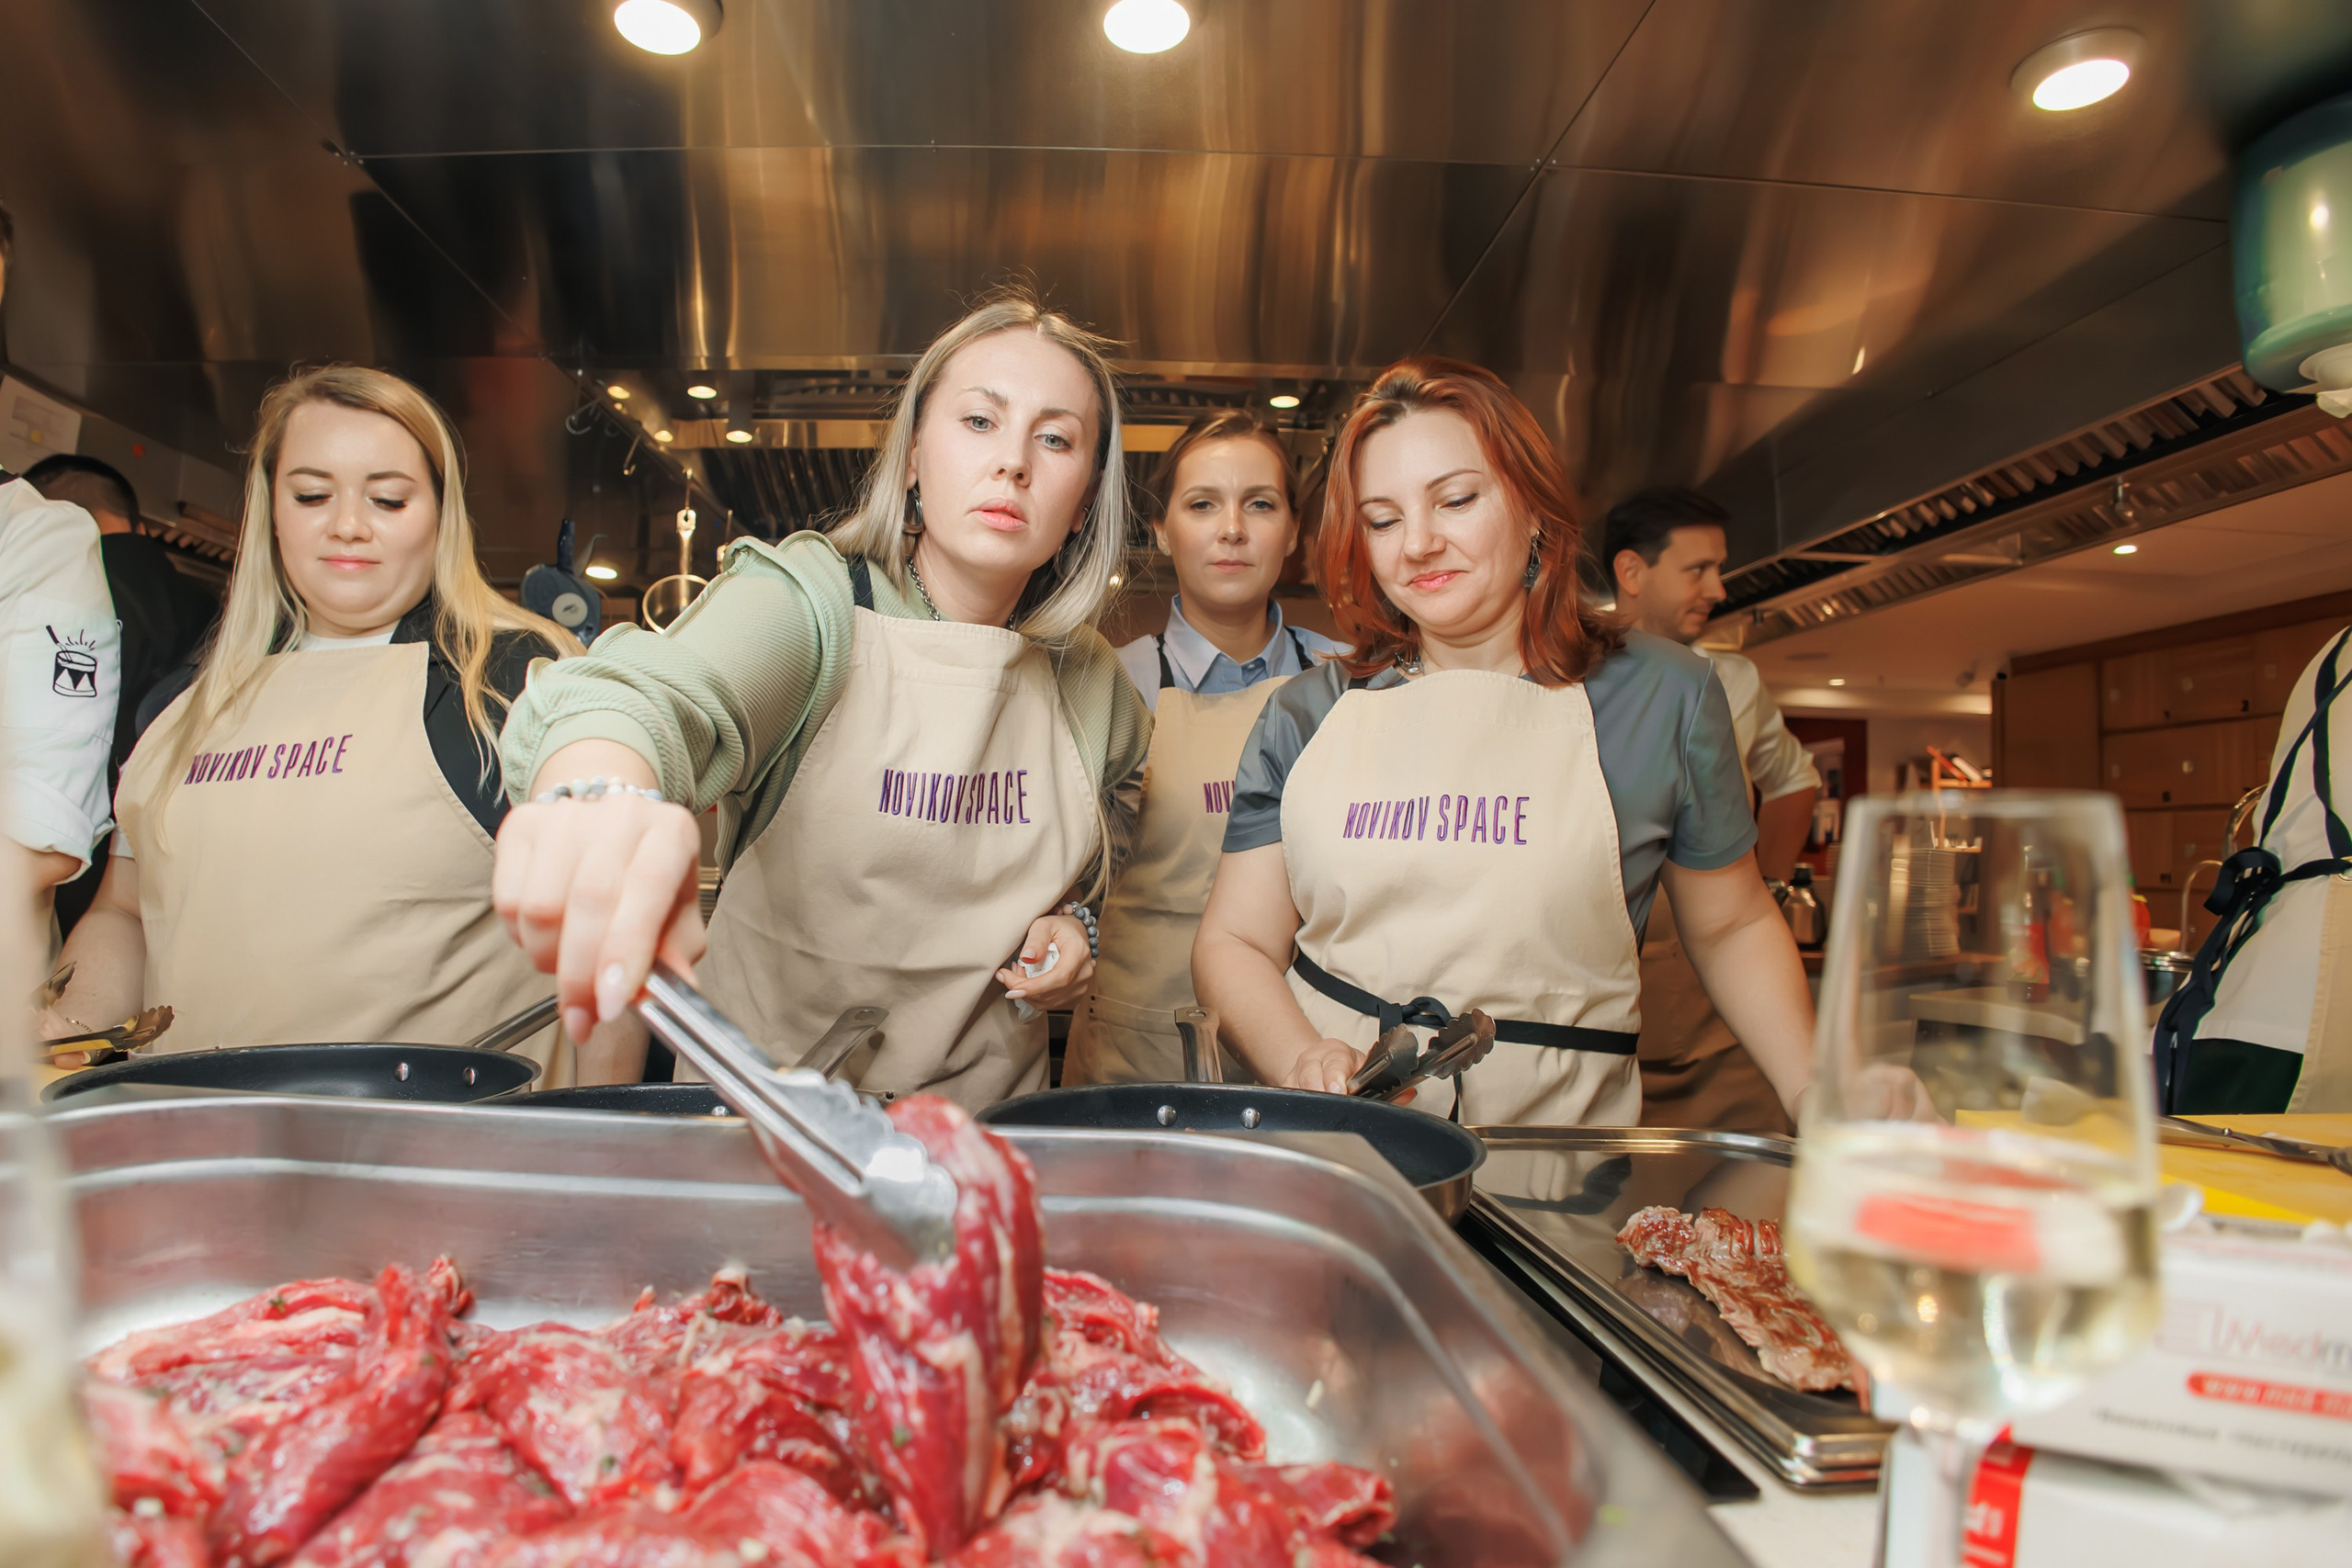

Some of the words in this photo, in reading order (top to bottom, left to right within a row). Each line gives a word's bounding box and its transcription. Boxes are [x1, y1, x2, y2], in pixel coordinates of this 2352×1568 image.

[185, 744, 268, 784] NOVIKOV
[267, 734, 353, 779] SPACE
[878, 769, 967, 824] NOVIKOV
[965, 769, 1031, 824] SPACE
[1343, 795, 1430, 840] NOVIKOV
[1437, 795, 1530, 844] SPACE
